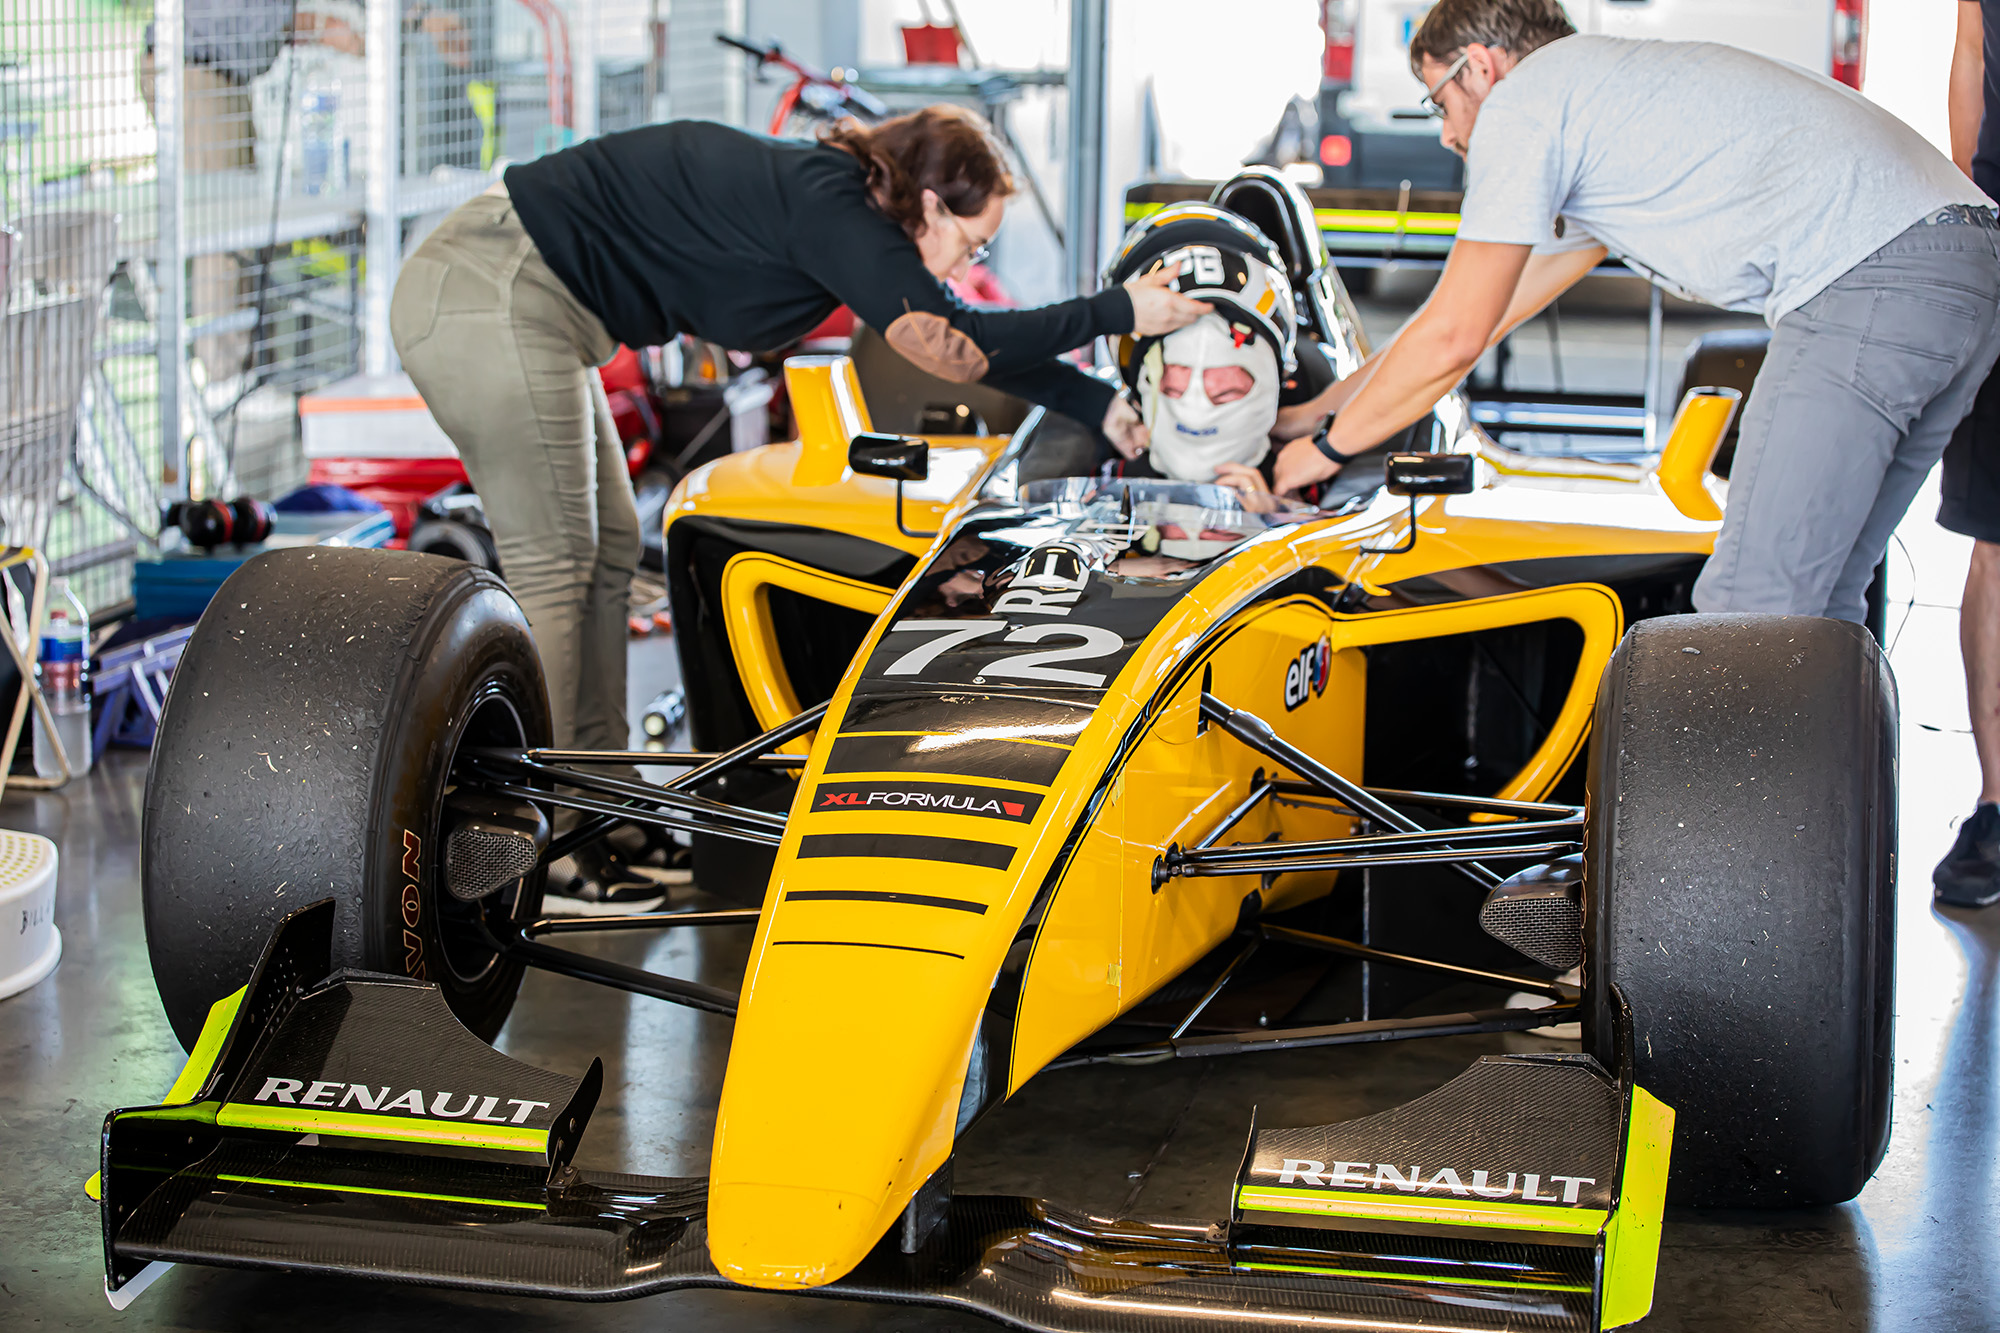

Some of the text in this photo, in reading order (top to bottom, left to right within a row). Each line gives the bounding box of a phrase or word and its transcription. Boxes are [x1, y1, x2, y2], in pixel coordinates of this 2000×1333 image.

[883, 620, 1124, 687] 72
[1285, 648, 1315, 707] elf
[254, 1076, 550, 1124] RENAULT
[1278, 1158, 1596, 1203] RENAULT
